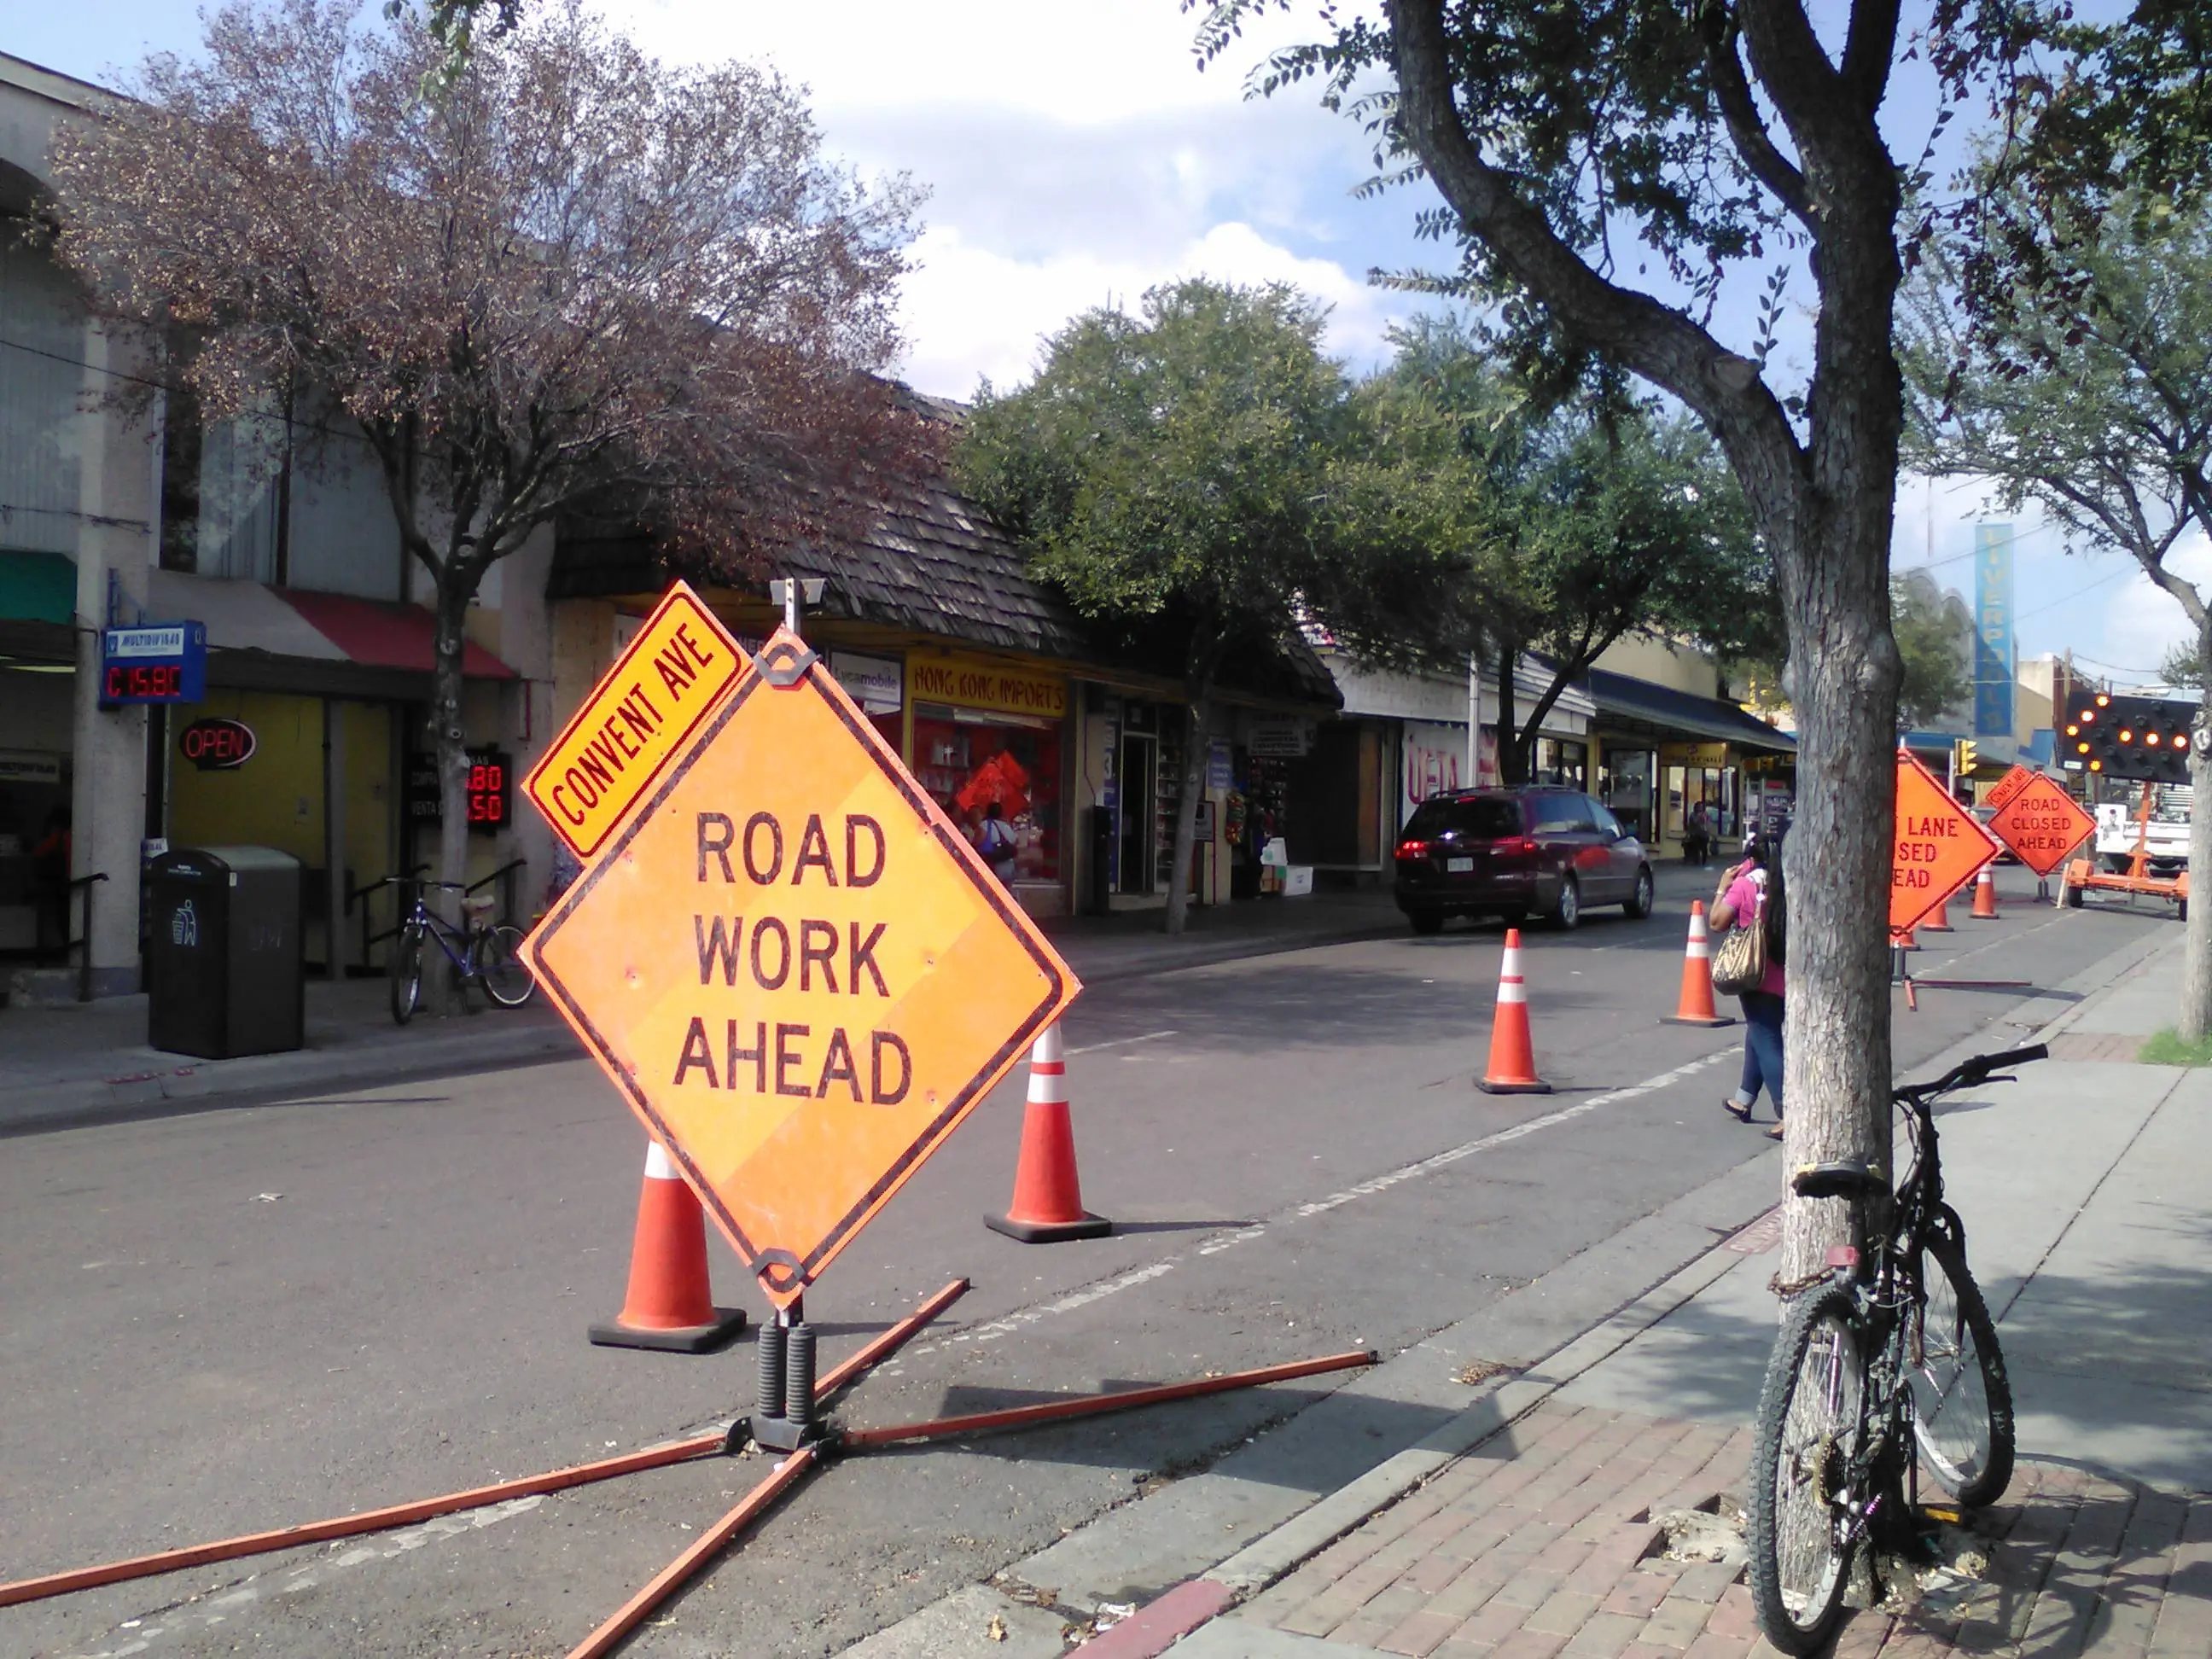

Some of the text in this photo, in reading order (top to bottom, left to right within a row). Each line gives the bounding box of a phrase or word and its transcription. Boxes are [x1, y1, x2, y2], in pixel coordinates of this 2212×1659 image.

[914, 666, 1064, 710] HONG KONG IMPORTS
[552, 622, 714, 826] CONVENT AVE
[186, 730, 244, 758] OPEN
[2020, 798, 2060, 812] ROAD
[1907, 816, 1959, 837] LANE
[2011, 817, 2071, 830] CLOSED
[696, 811, 888, 888] ROAD
[1898, 842, 1937, 864] SED
[2017, 836, 2067, 850] AHEAD
[1893, 868, 1930, 888] EAD
[693, 914, 890, 998] WORK
[672, 1016, 913, 1106] AHEAD
